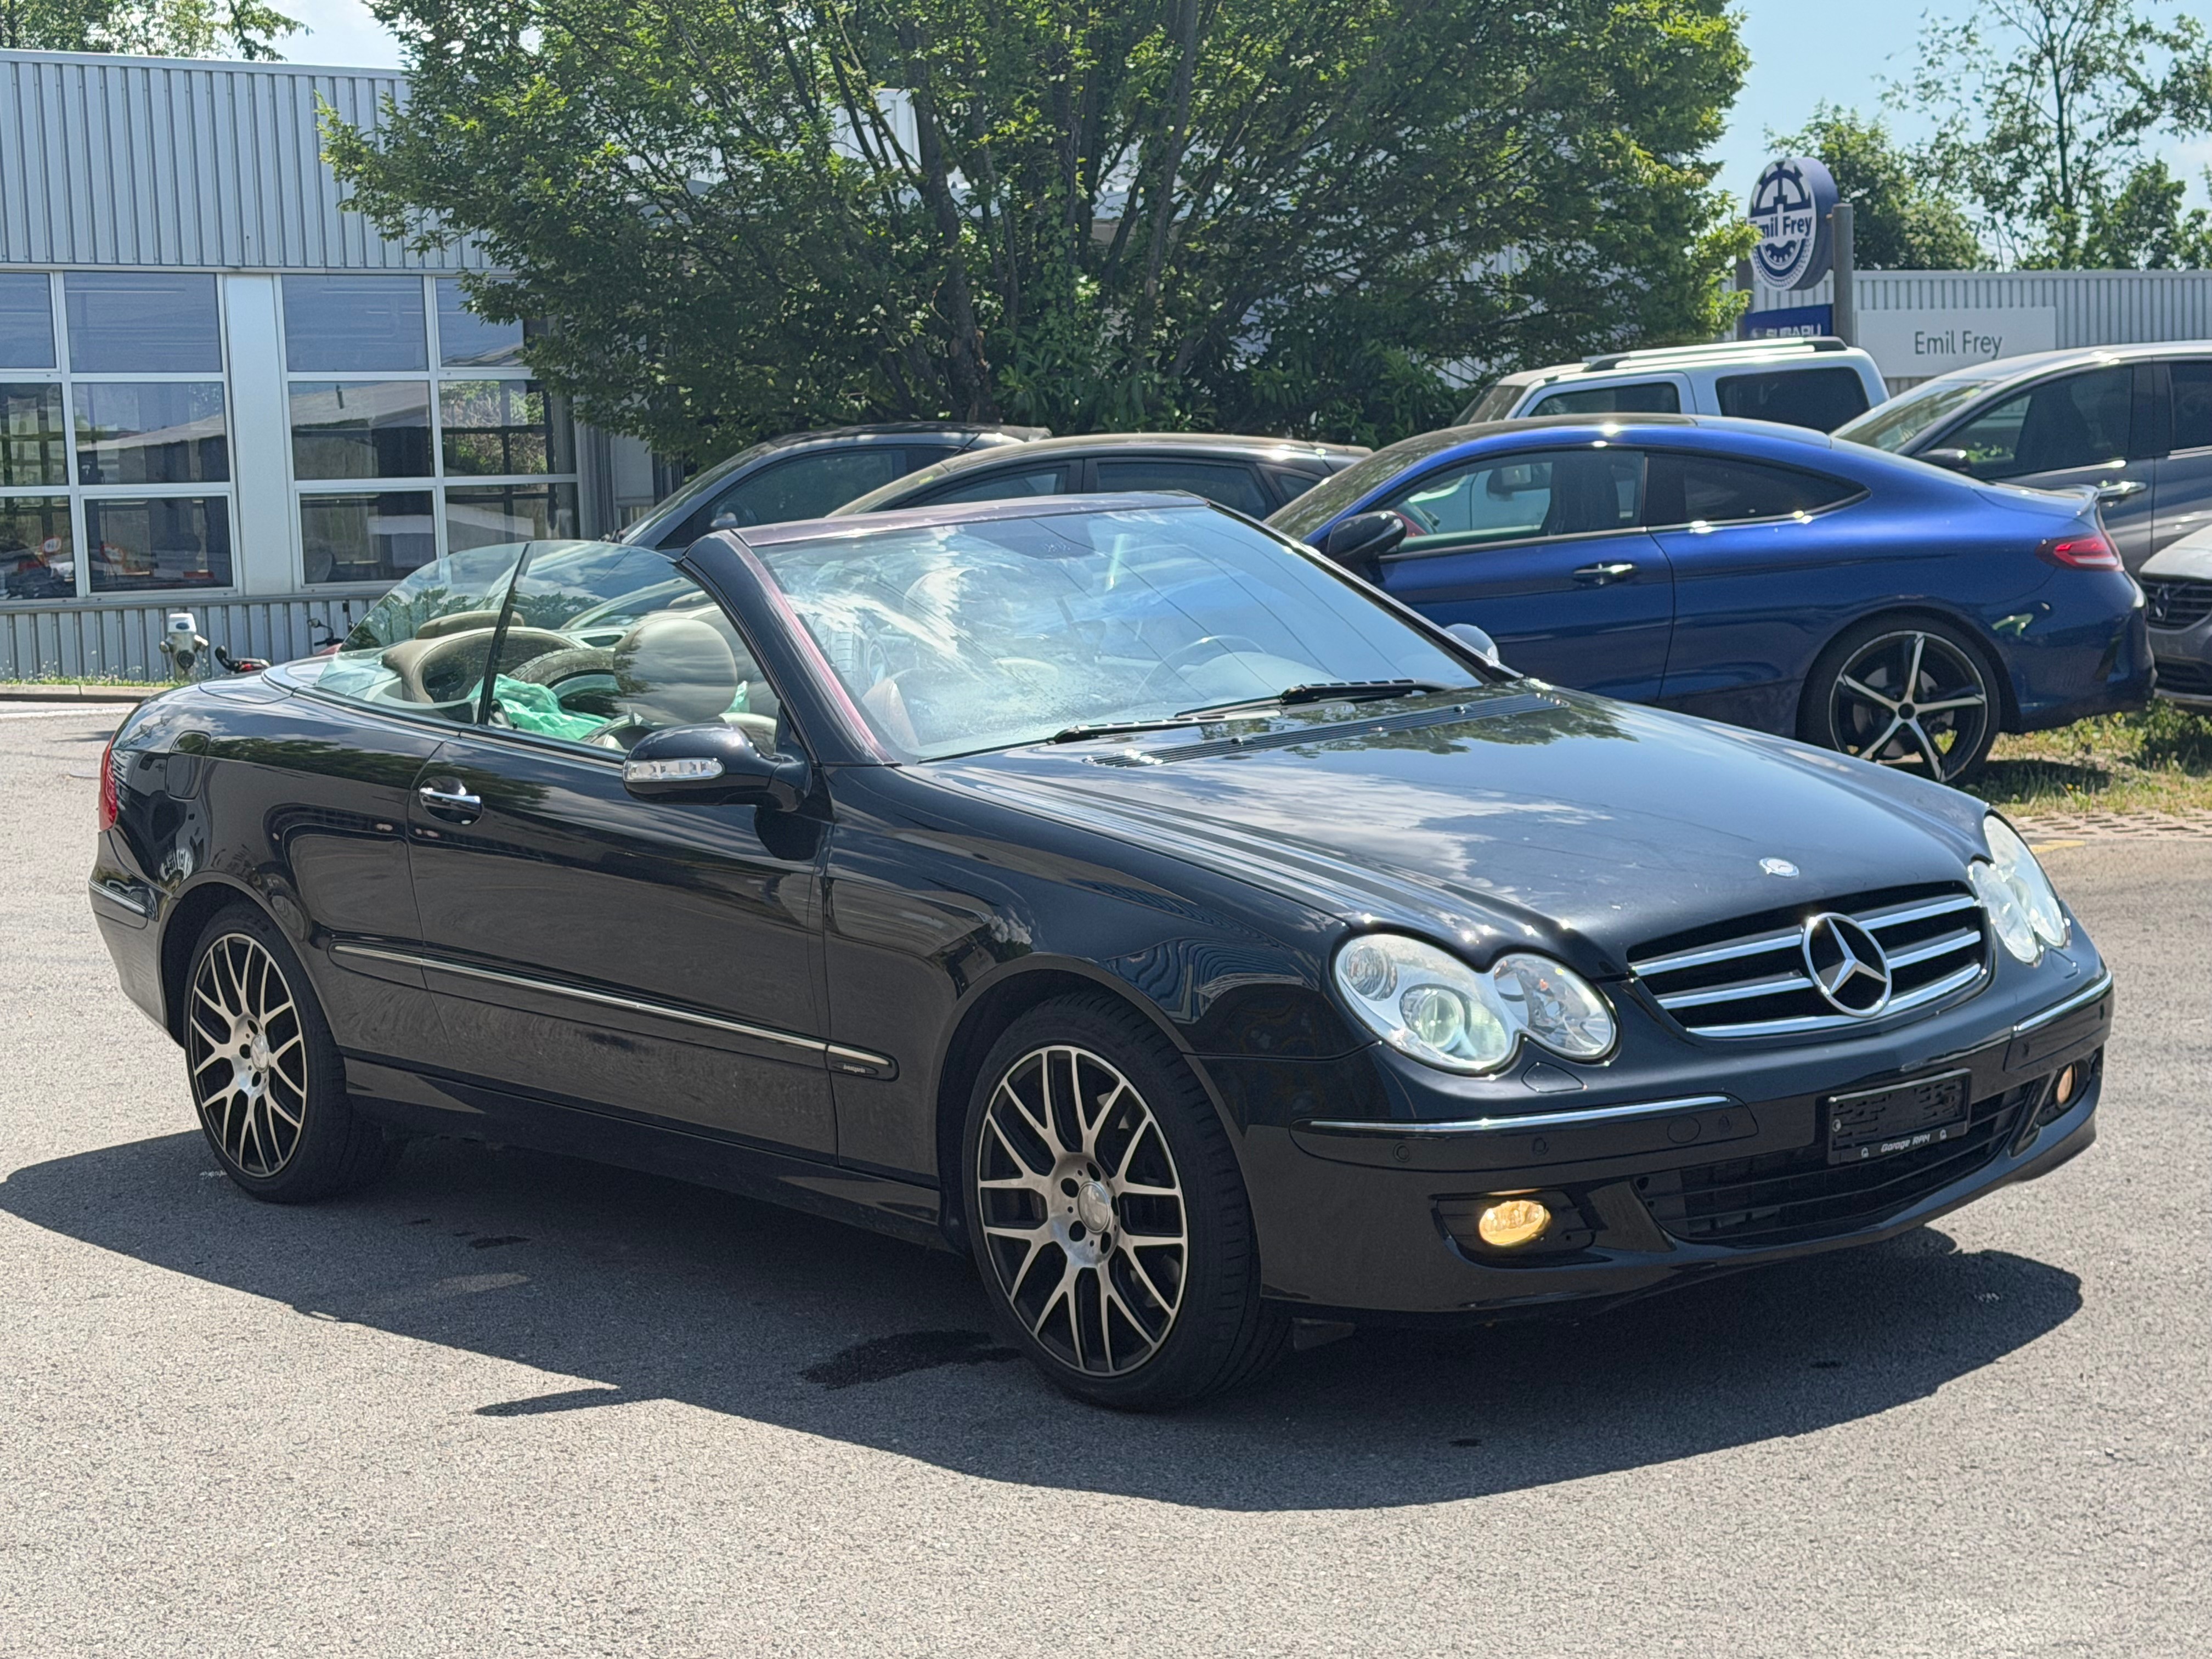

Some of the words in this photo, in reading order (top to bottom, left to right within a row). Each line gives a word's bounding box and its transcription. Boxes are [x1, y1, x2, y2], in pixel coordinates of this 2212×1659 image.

[1783, 216, 1812, 236] Frey
[1915, 330, 1956, 354] Emil
[1963, 330, 2002, 360] Frey
[1881, 1139, 1911, 1153] Garage
